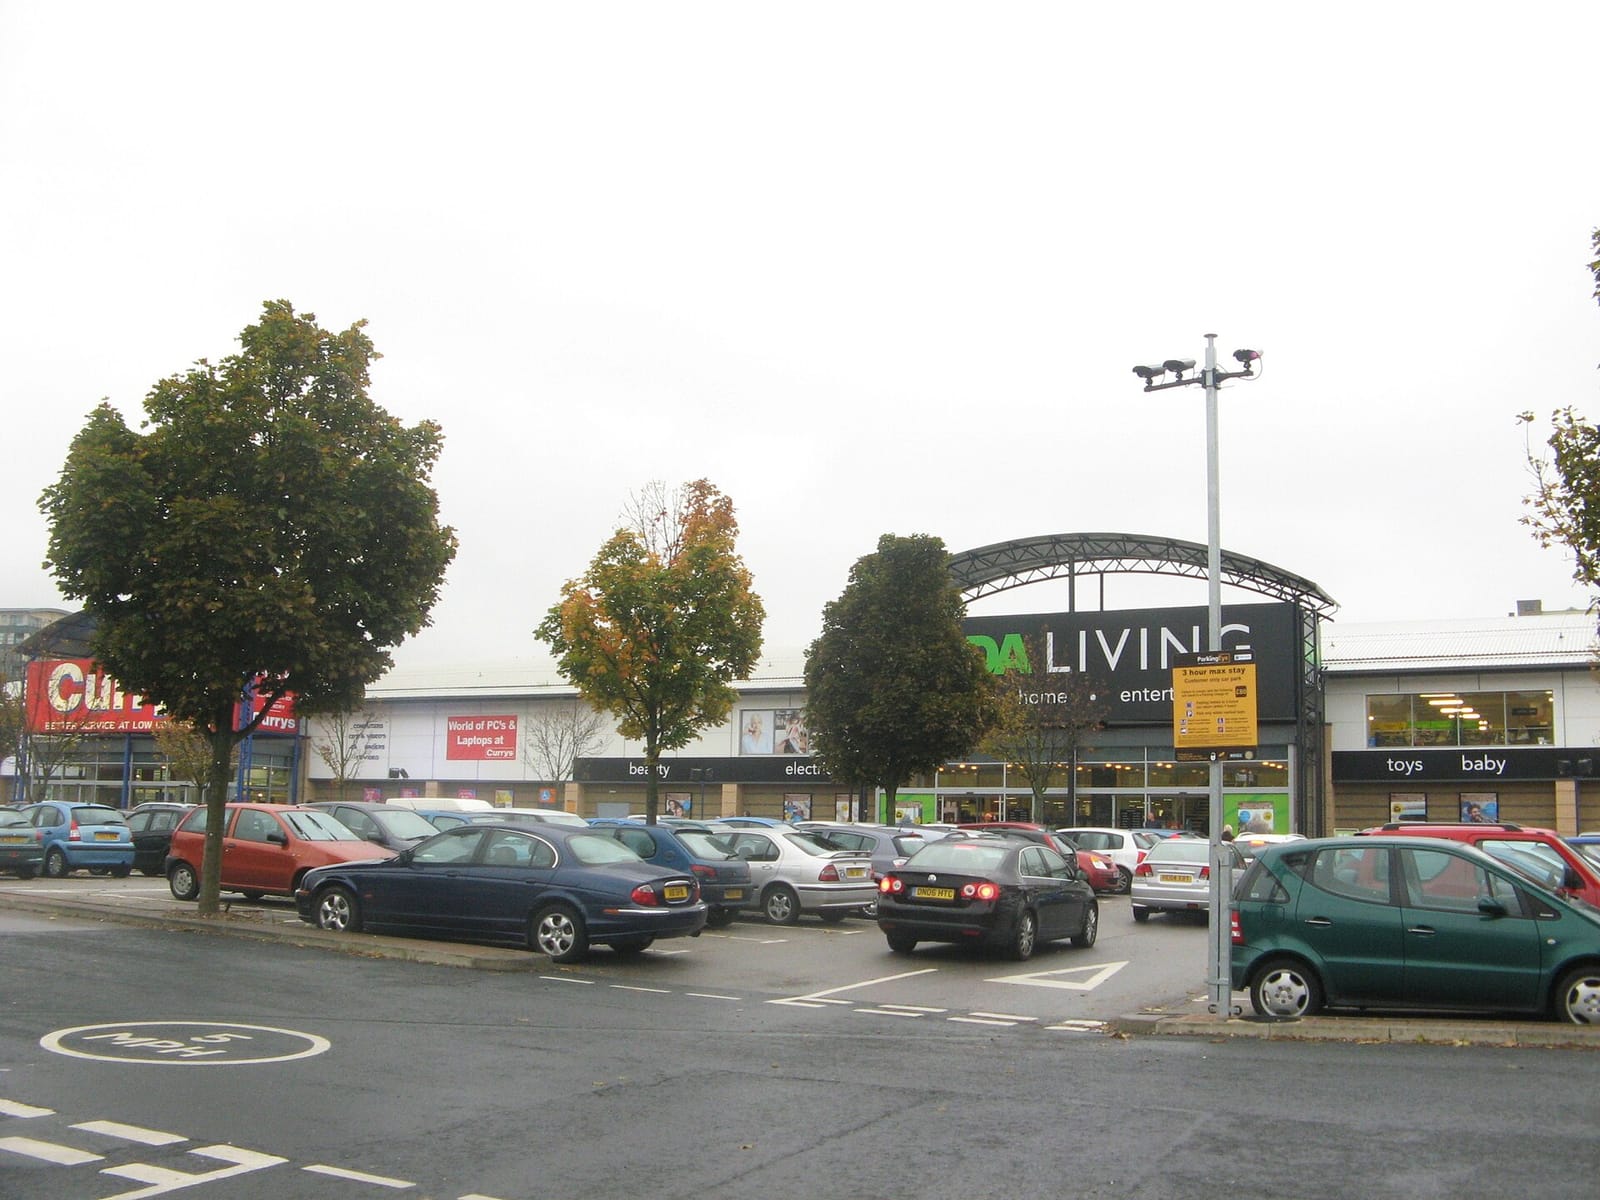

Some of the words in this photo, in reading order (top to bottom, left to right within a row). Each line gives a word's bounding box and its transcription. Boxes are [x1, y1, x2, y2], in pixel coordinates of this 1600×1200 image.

[1182, 669, 1188, 677] 3
[1228, 667, 1246, 675] stay
[118, 721, 129, 730] AT
[132, 721, 152, 730] LOW
[448, 720, 474, 731] World
[475, 720, 485, 731] of
[486, 720, 507, 731] PC's
[508, 719, 516, 731] &
[457, 735, 493, 748] Laptops
[494, 735, 504, 745] at
[486, 748, 514, 758] Currys
[629, 761, 671, 779] beaty
[1386, 757, 1424, 776] toys
[1461, 753, 1507, 776] baby
